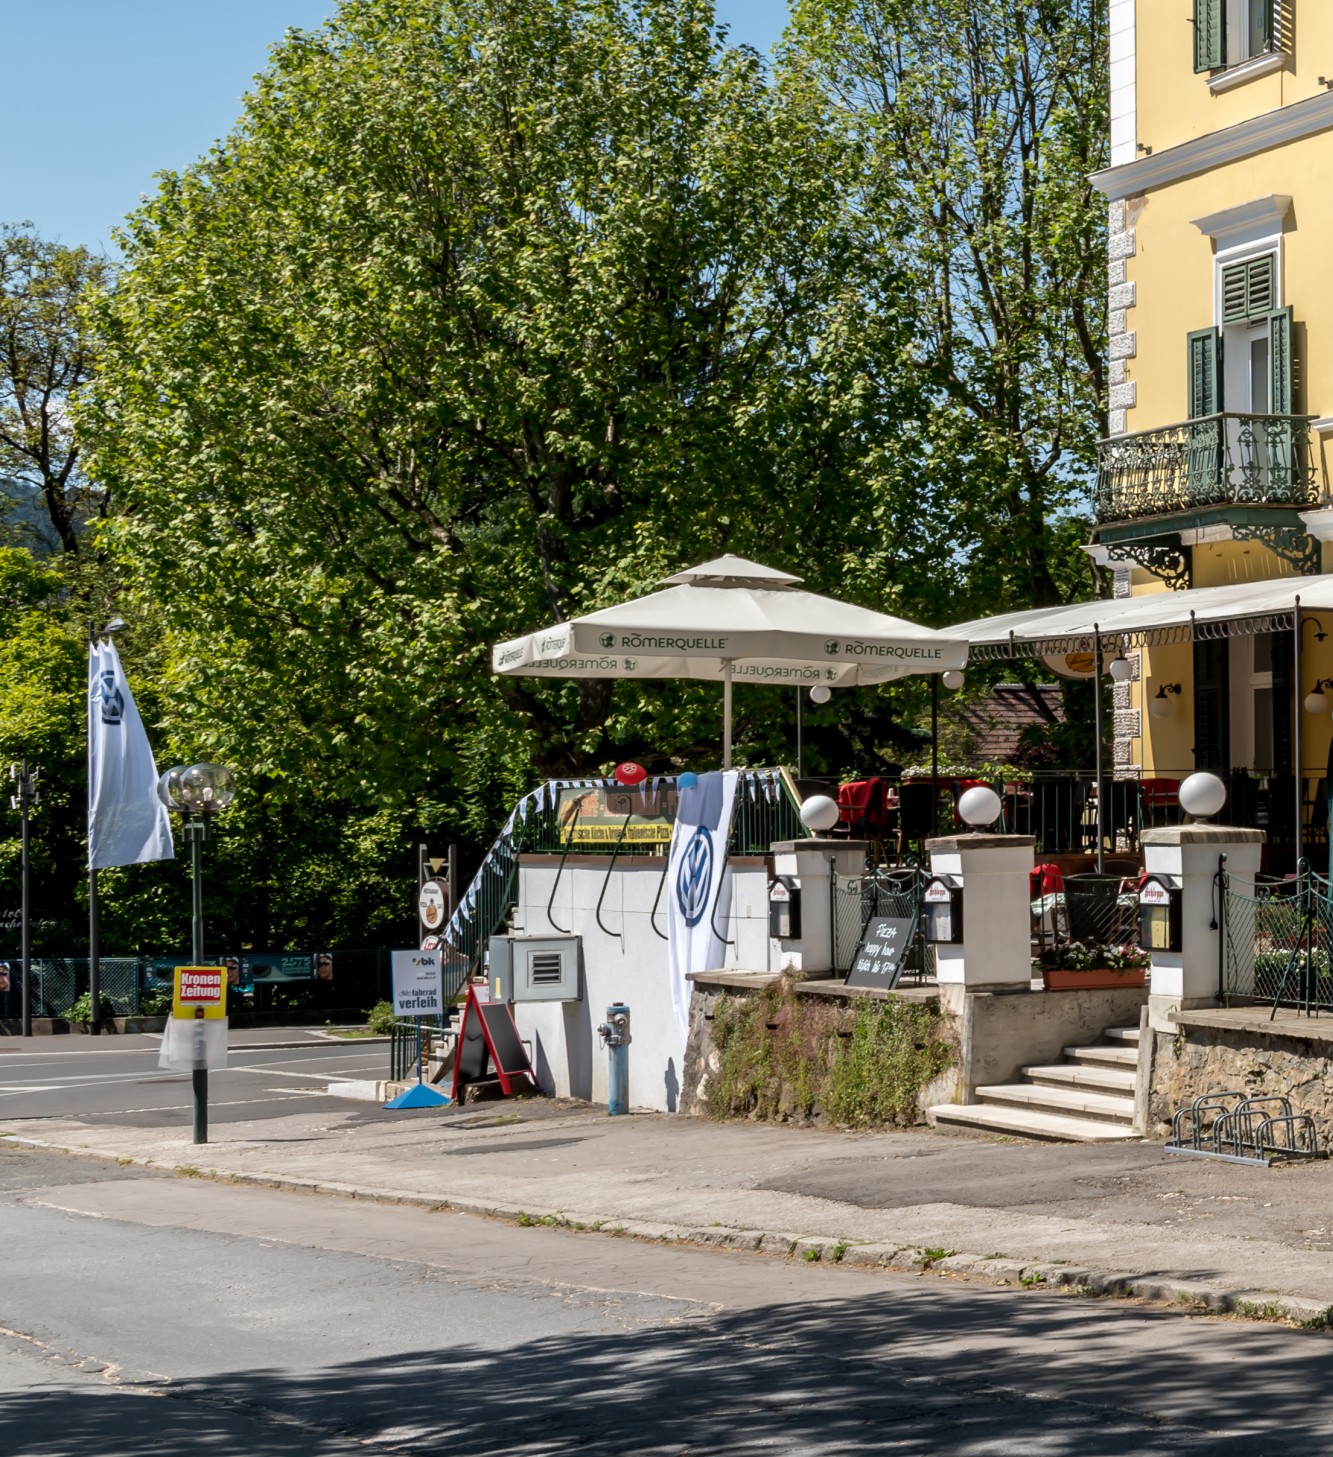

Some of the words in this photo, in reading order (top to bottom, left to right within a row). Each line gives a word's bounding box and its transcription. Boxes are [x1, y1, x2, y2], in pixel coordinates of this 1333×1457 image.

[181, 973, 221, 985] Kronen
[180, 985, 220, 998] Zeitung
[399, 996, 437, 1009] verleih
